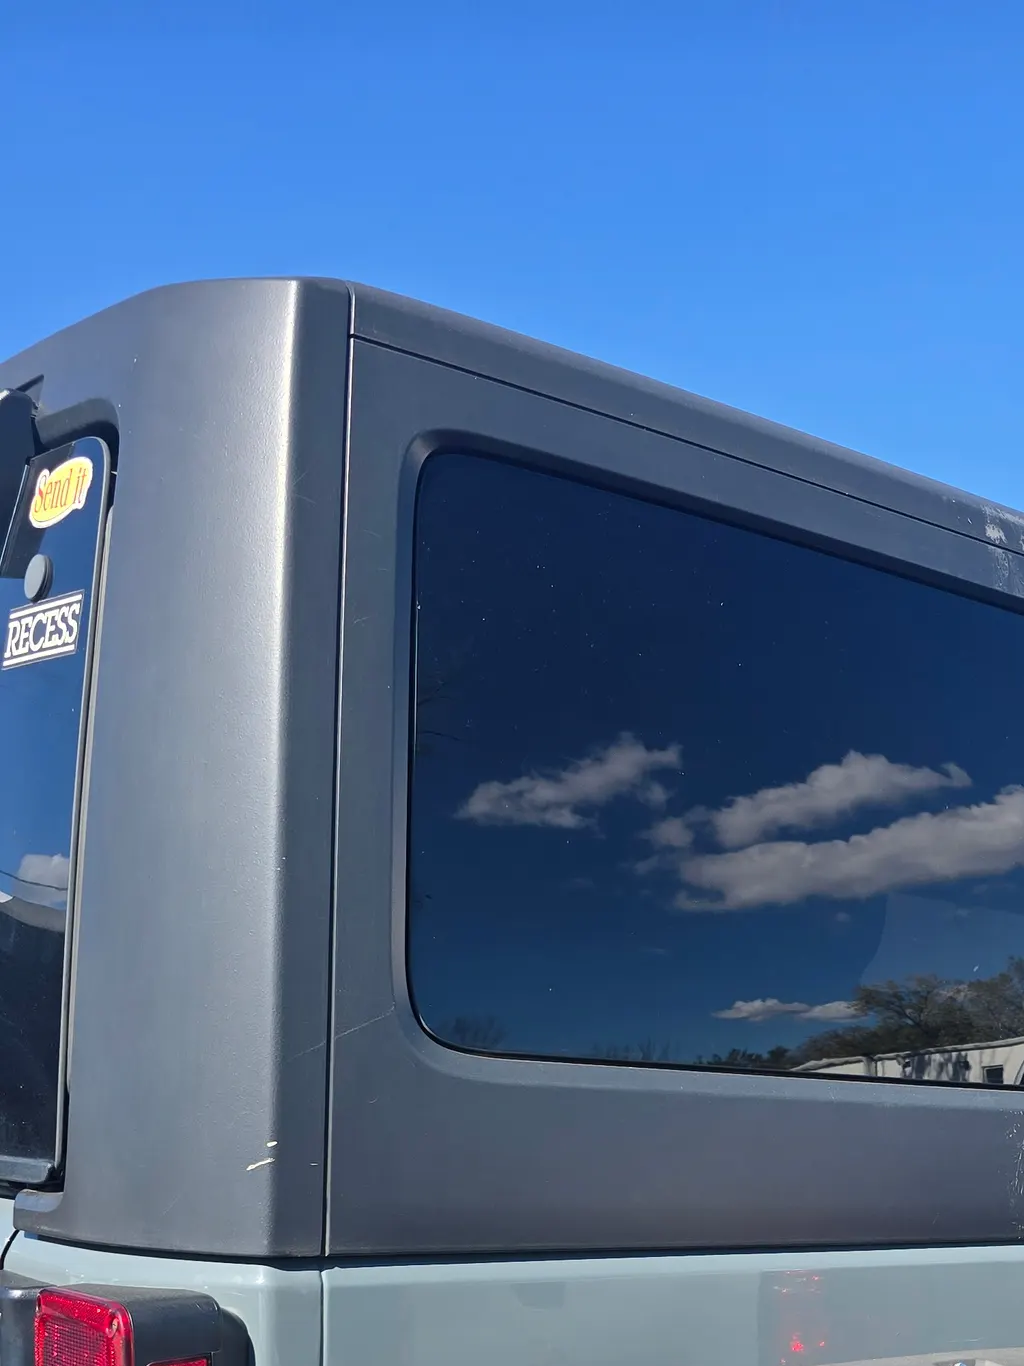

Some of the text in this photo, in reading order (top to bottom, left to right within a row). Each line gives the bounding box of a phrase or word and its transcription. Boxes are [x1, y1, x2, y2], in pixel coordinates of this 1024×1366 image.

[34, 464, 88, 513] Send it
[4, 602, 81, 658] RECESS
